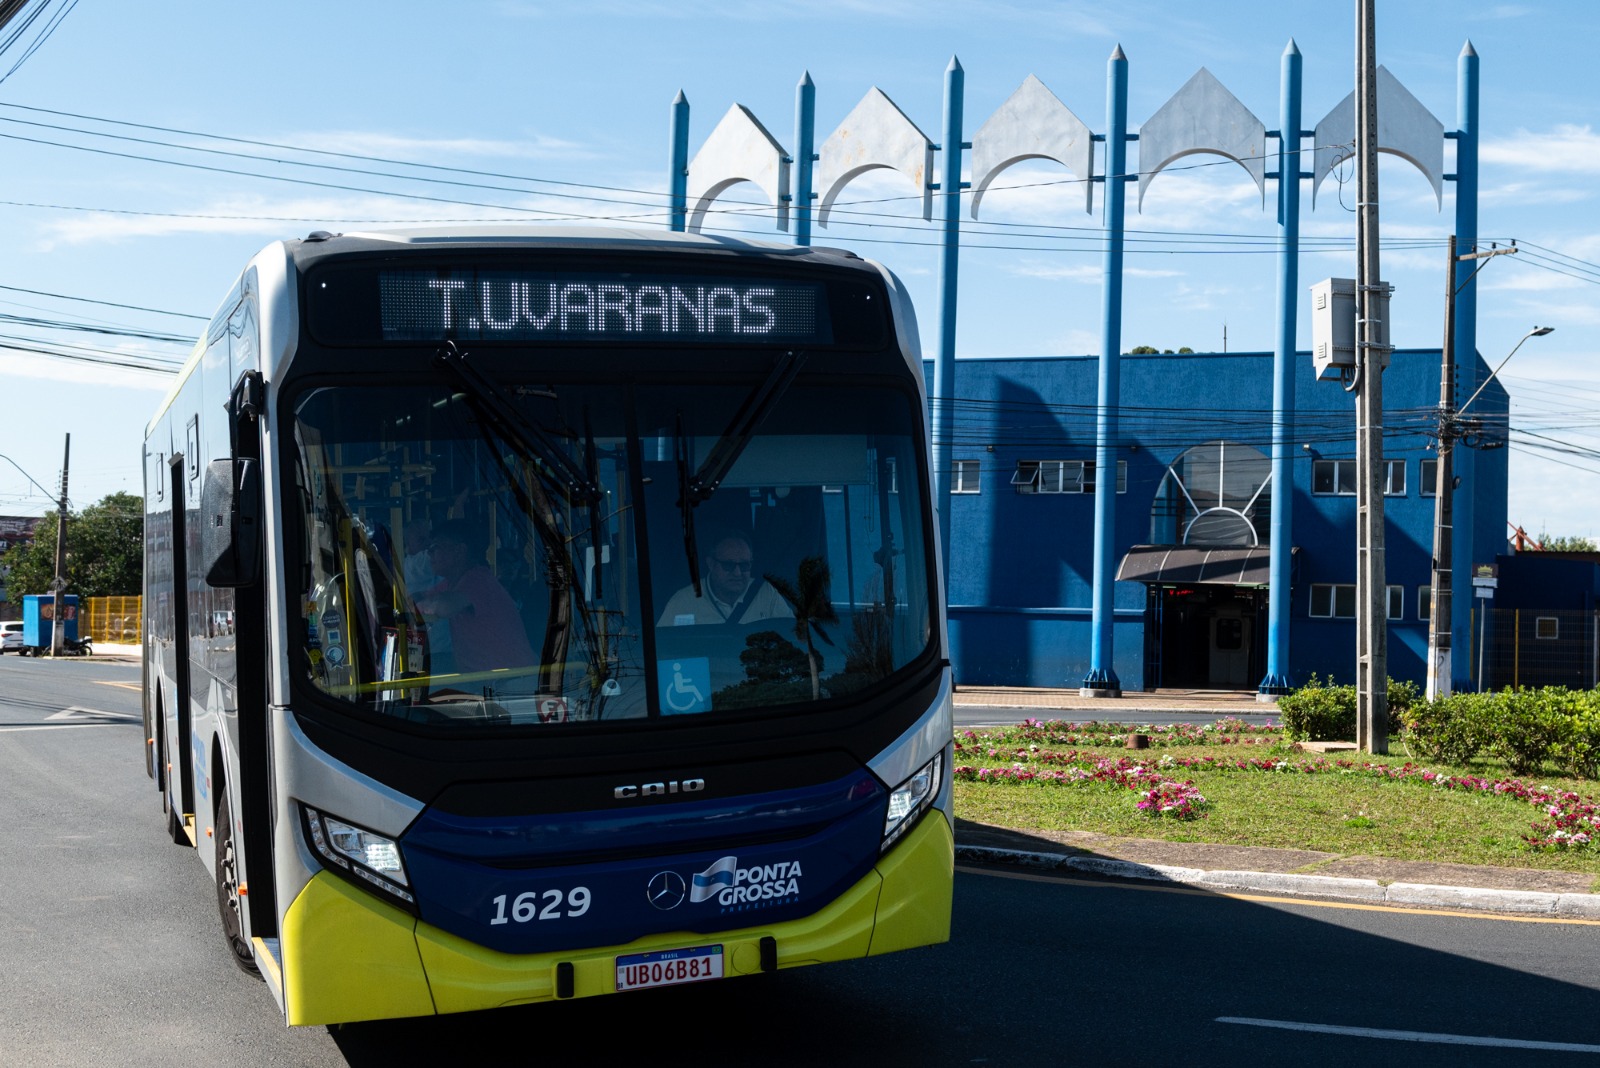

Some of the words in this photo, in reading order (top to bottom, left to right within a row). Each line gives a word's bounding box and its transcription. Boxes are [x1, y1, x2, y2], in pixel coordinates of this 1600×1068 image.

[428, 279, 775, 334] T.UVARANAS
[614, 778, 704, 798] CAIO
[734, 860, 802, 886] PONTA
[718, 878, 799, 906] GROSSA
[720, 896, 799, 914] PREFEITURA
[490, 886, 592, 925] 1629
[660, 952, 679, 960] BRASIL
